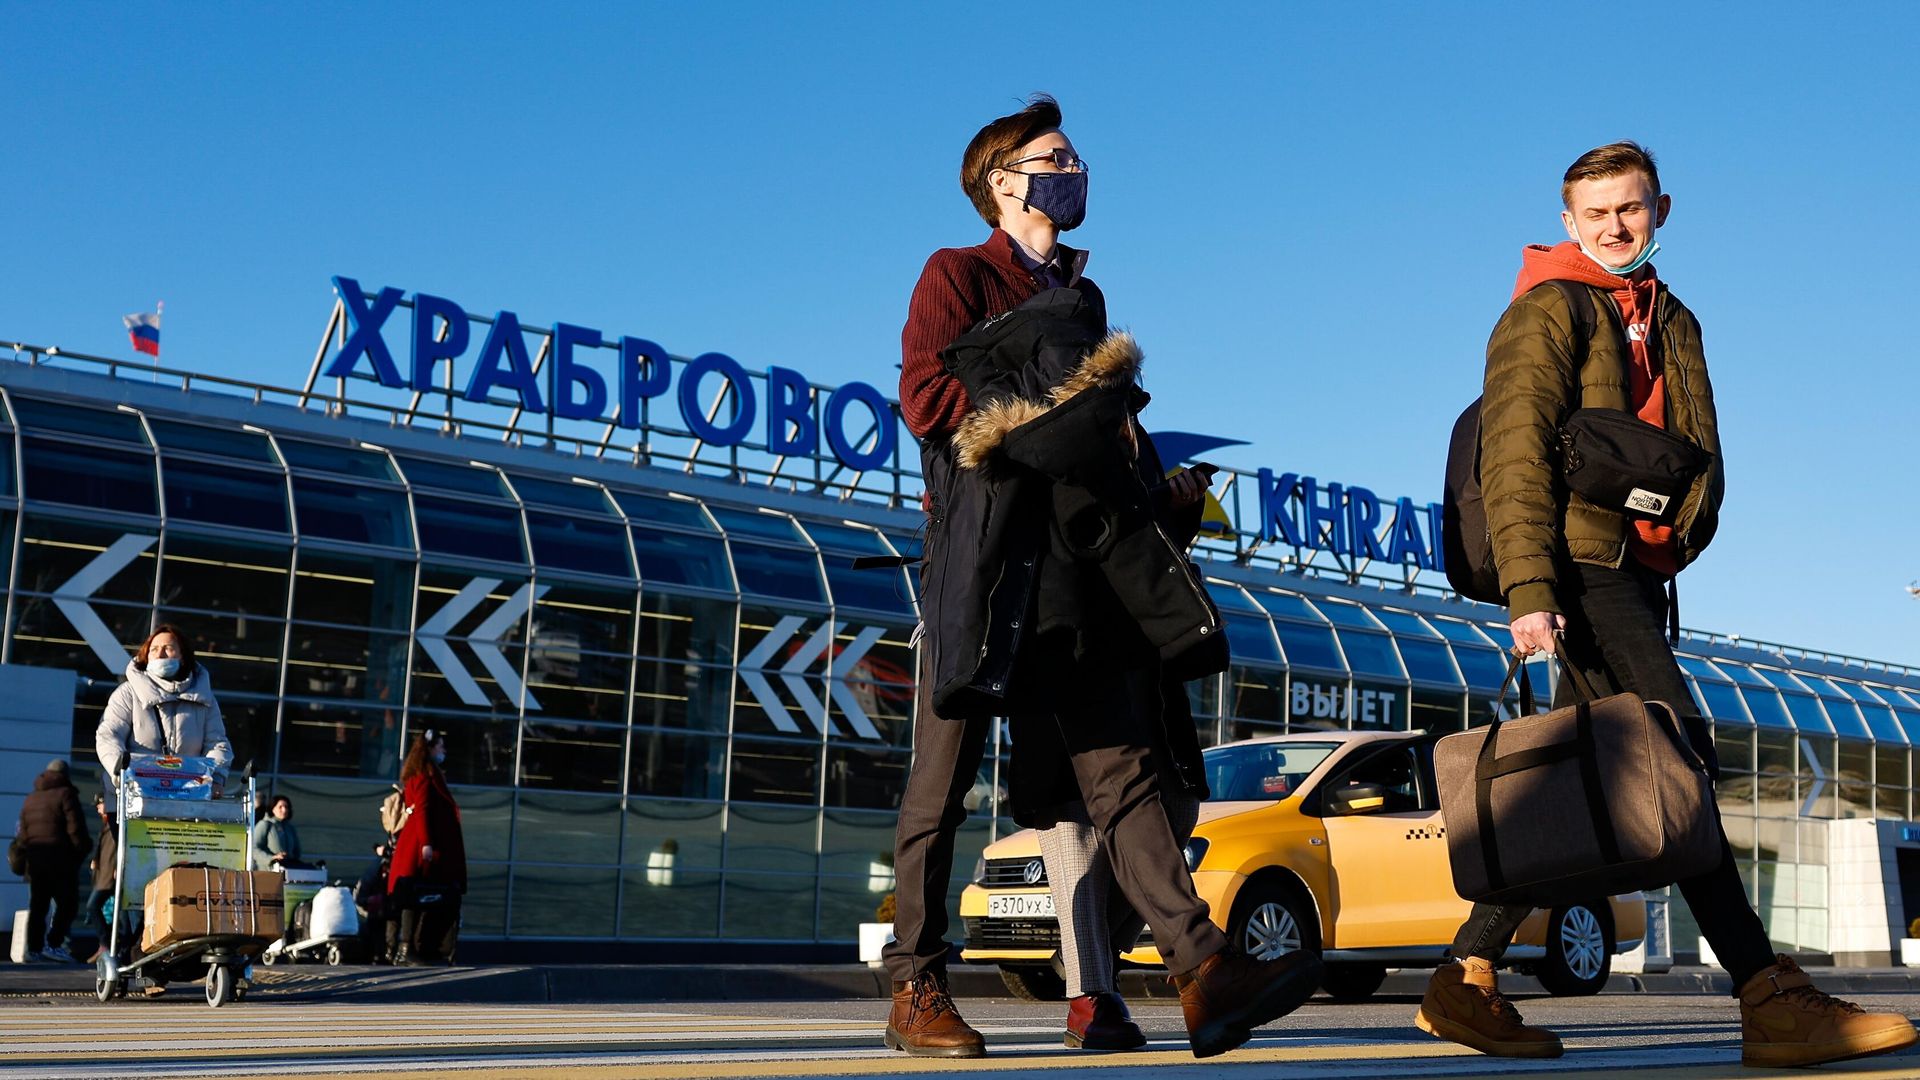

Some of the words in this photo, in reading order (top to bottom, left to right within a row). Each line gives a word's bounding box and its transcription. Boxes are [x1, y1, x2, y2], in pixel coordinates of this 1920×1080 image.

[324, 275, 897, 471] ХРАБРОВО
[1631, 495, 1653, 506] NORTH
[1292, 681, 1395, 724] ВЫЛЕТ
[1045, 895, 1052, 909] 3
